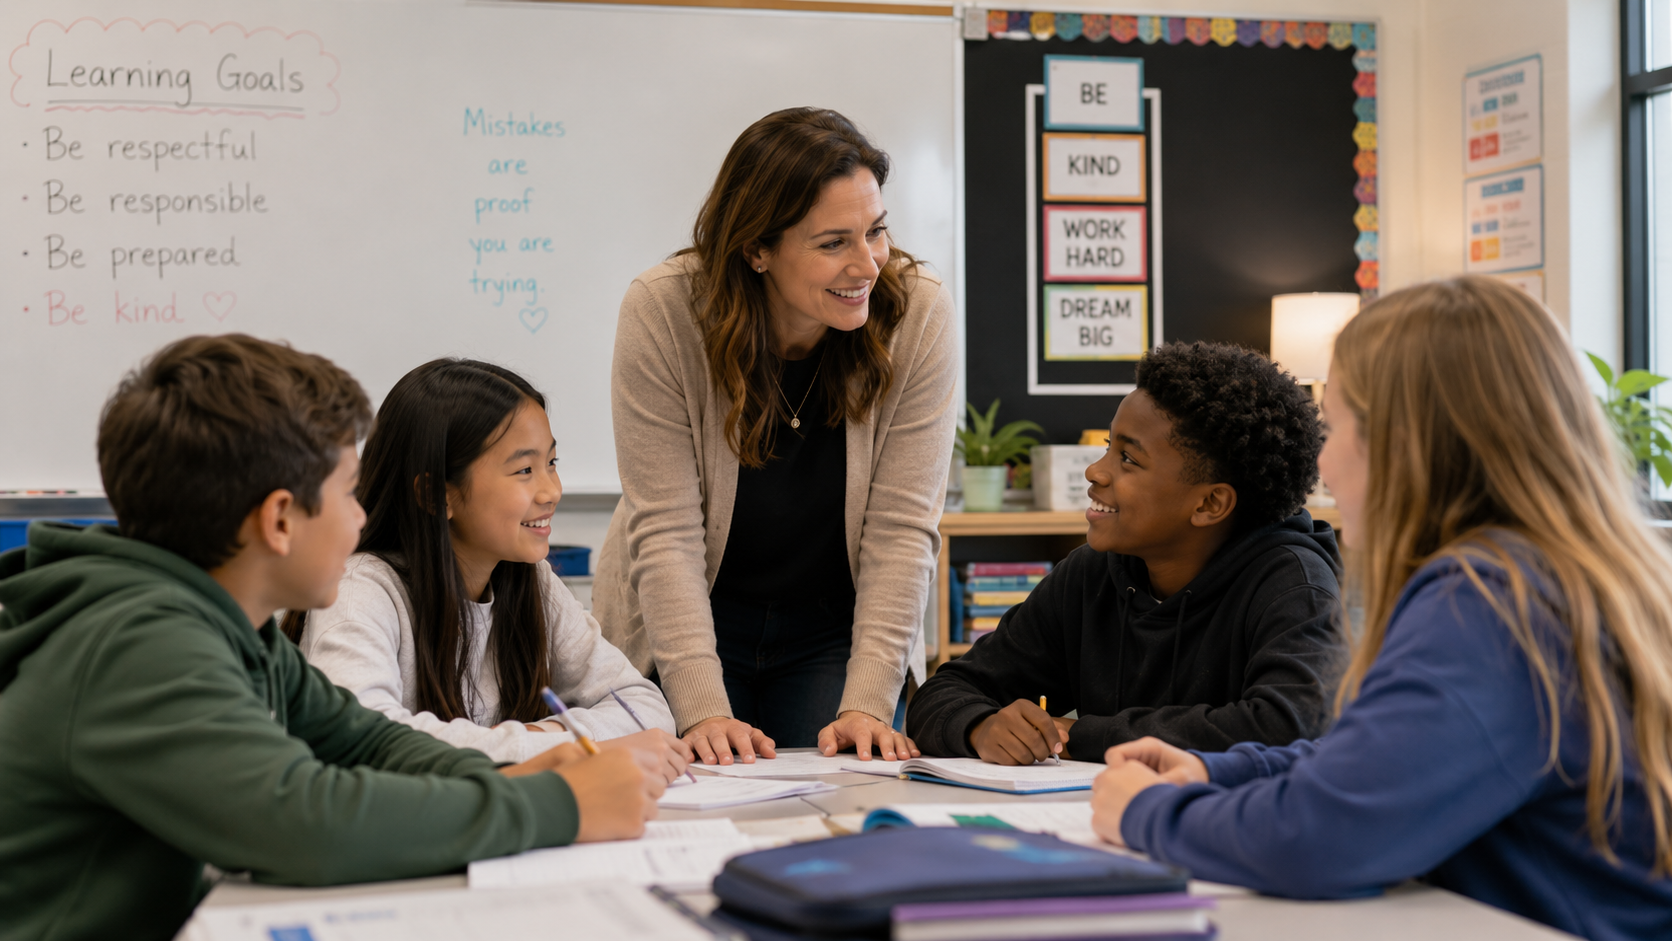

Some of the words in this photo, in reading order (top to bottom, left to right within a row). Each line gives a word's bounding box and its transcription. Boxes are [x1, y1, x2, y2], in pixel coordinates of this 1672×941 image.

[47, 48, 193, 108] Learning
[216, 52, 305, 94] Goals
[1080, 82, 1108, 105] BE
[463, 107, 566, 138] Mistakes
[42, 125, 85, 162] Be
[108, 127, 257, 172] respectful
[487, 158, 528, 175] are
[1067, 154, 1121, 177] KIND
[43, 178, 86, 215] Be
[109, 181, 270, 226] responsible
[474, 187, 535, 225] proof
[1063, 218, 1126, 241] WORK
[43, 233, 87, 270] Be
[111, 235, 242, 280] prepared
[468, 238, 508, 266] you
[518, 237, 555, 253] are
[1065, 247, 1125, 269] HARD
[44, 289, 88, 326] Be
[114, 290, 186, 324] kind
[1059, 298, 1132, 320] DREAM
[1078, 325, 1114, 347] BIG
